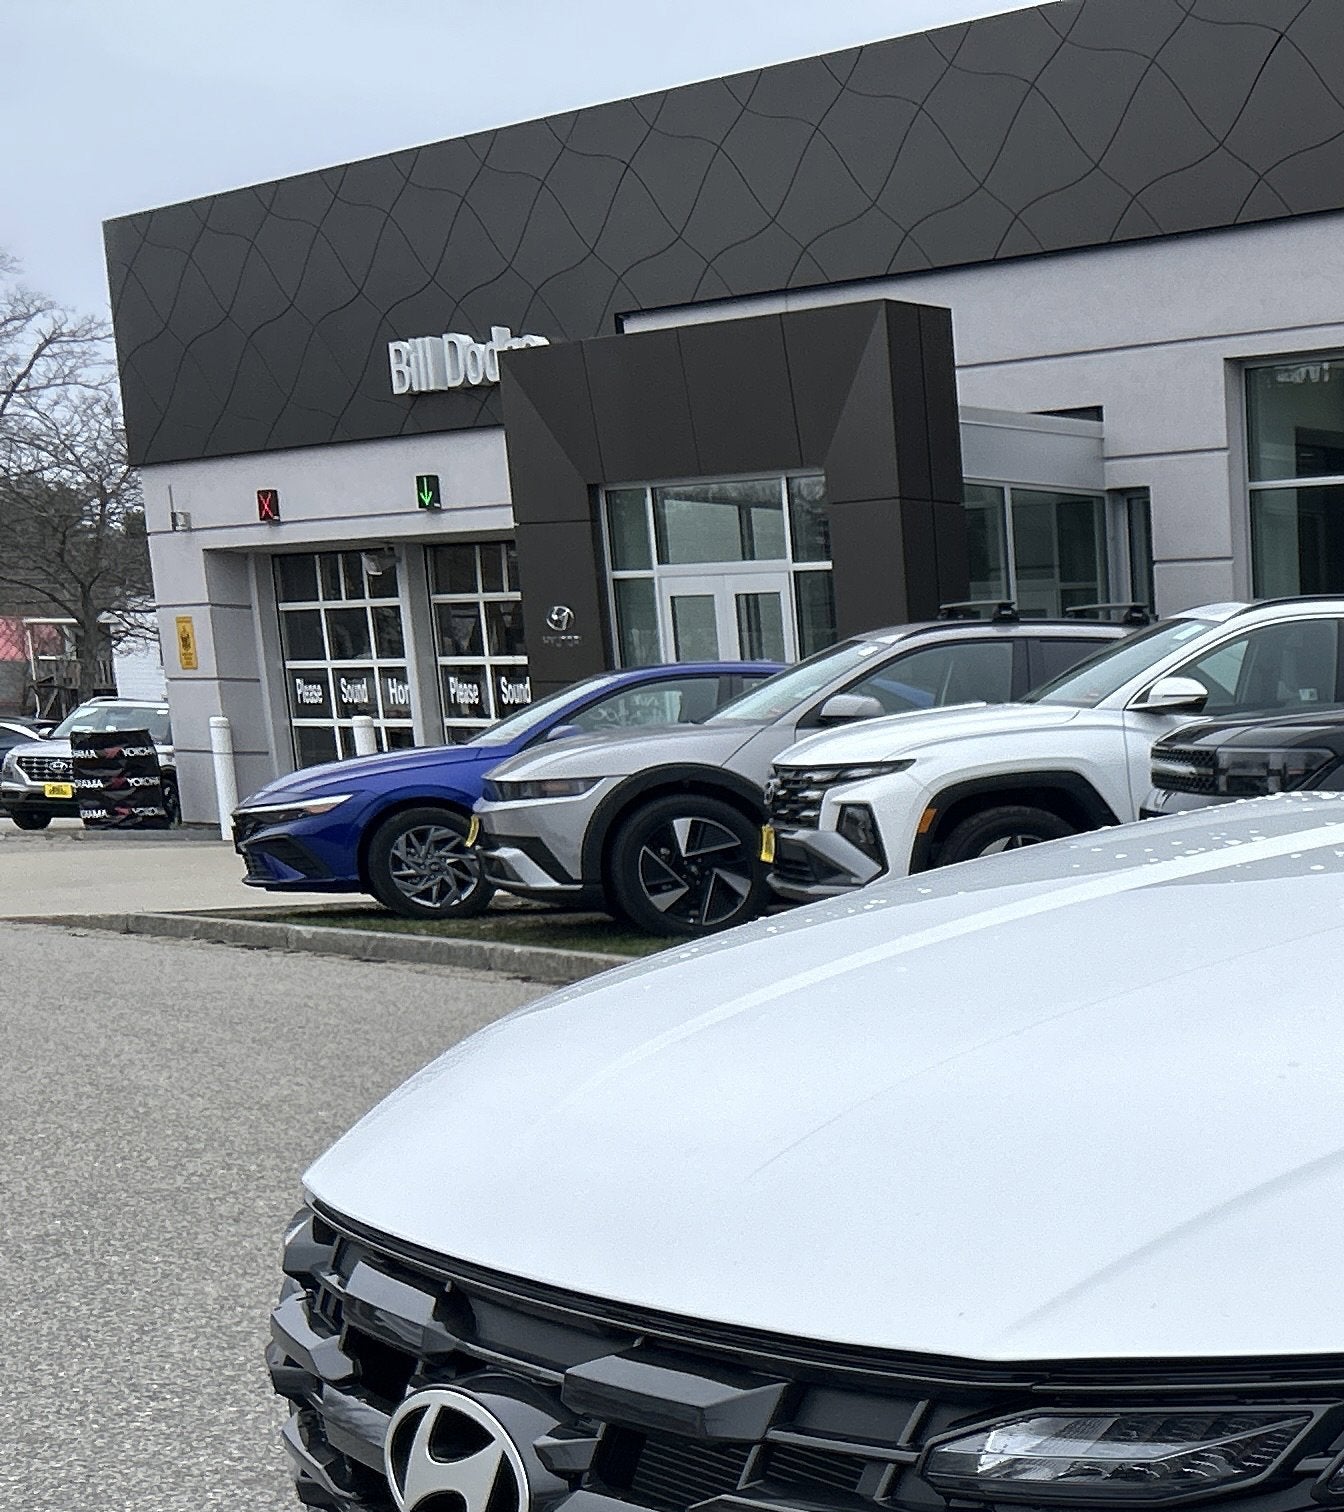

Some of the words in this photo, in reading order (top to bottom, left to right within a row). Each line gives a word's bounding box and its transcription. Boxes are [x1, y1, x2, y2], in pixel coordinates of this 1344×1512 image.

[389, 337, 448, 394] Bill
[443, 326, 550, 387] Dod
[295, 678, 323, 704] Please
[340, 677, 369, 704] Sound
[387, 677, 410, 705] Hor
[448, 676, 479, 705] Please
[500, 676, 531, 705] Sound
